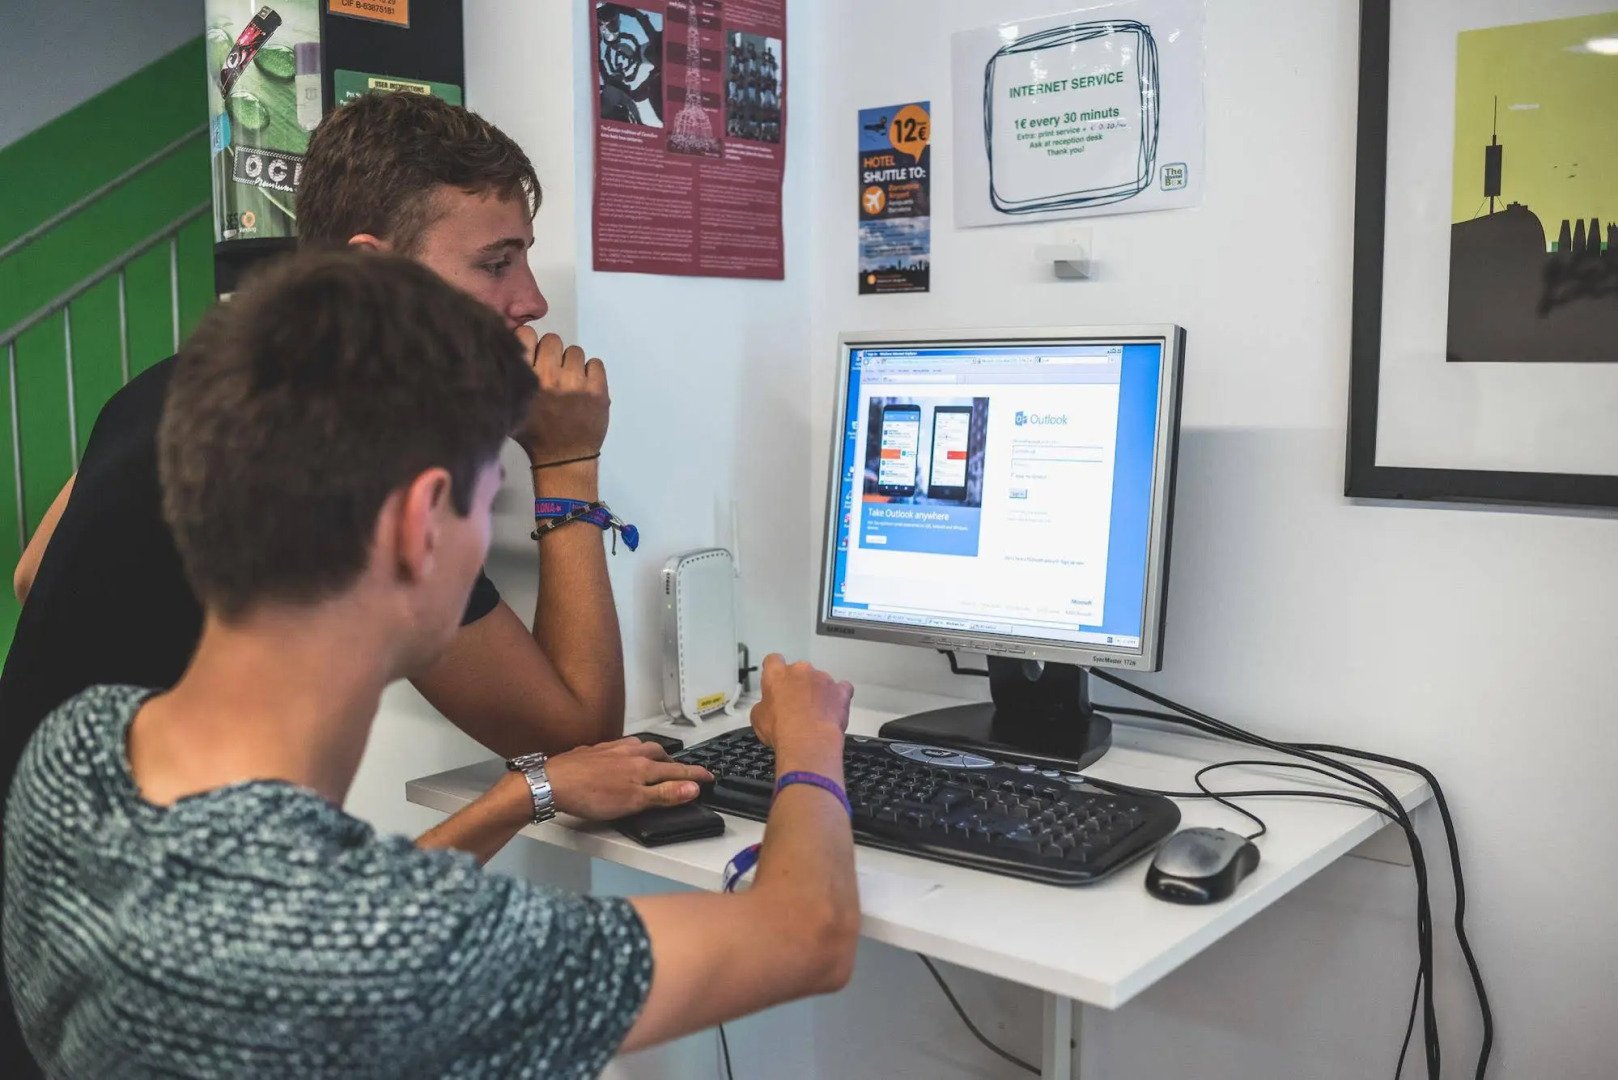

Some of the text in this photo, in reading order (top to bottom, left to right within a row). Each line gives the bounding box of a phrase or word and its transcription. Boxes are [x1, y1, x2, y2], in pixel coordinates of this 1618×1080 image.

[1009, 71, 1124, 98] INTERNET SERVICE
[1014, 107, 1120, 129] 1€ every 30 minuts
[1038, 129, 1054, 139] print
[1056, 127, 1080, 136] service
[1029, 133, 1103, 149] Ask at reception desk
[1047, 148, 1068, 156] Thank
[863, 155, 896, 168] HOTEL
[863, 166, 927, 183] SHUTTLE TO:
[1030, 414, 1068, 425] Outlook
[868, 508, 950, 522] Take Outlook anywhere
[1093, 655, 1122, 664] SyncMaster
